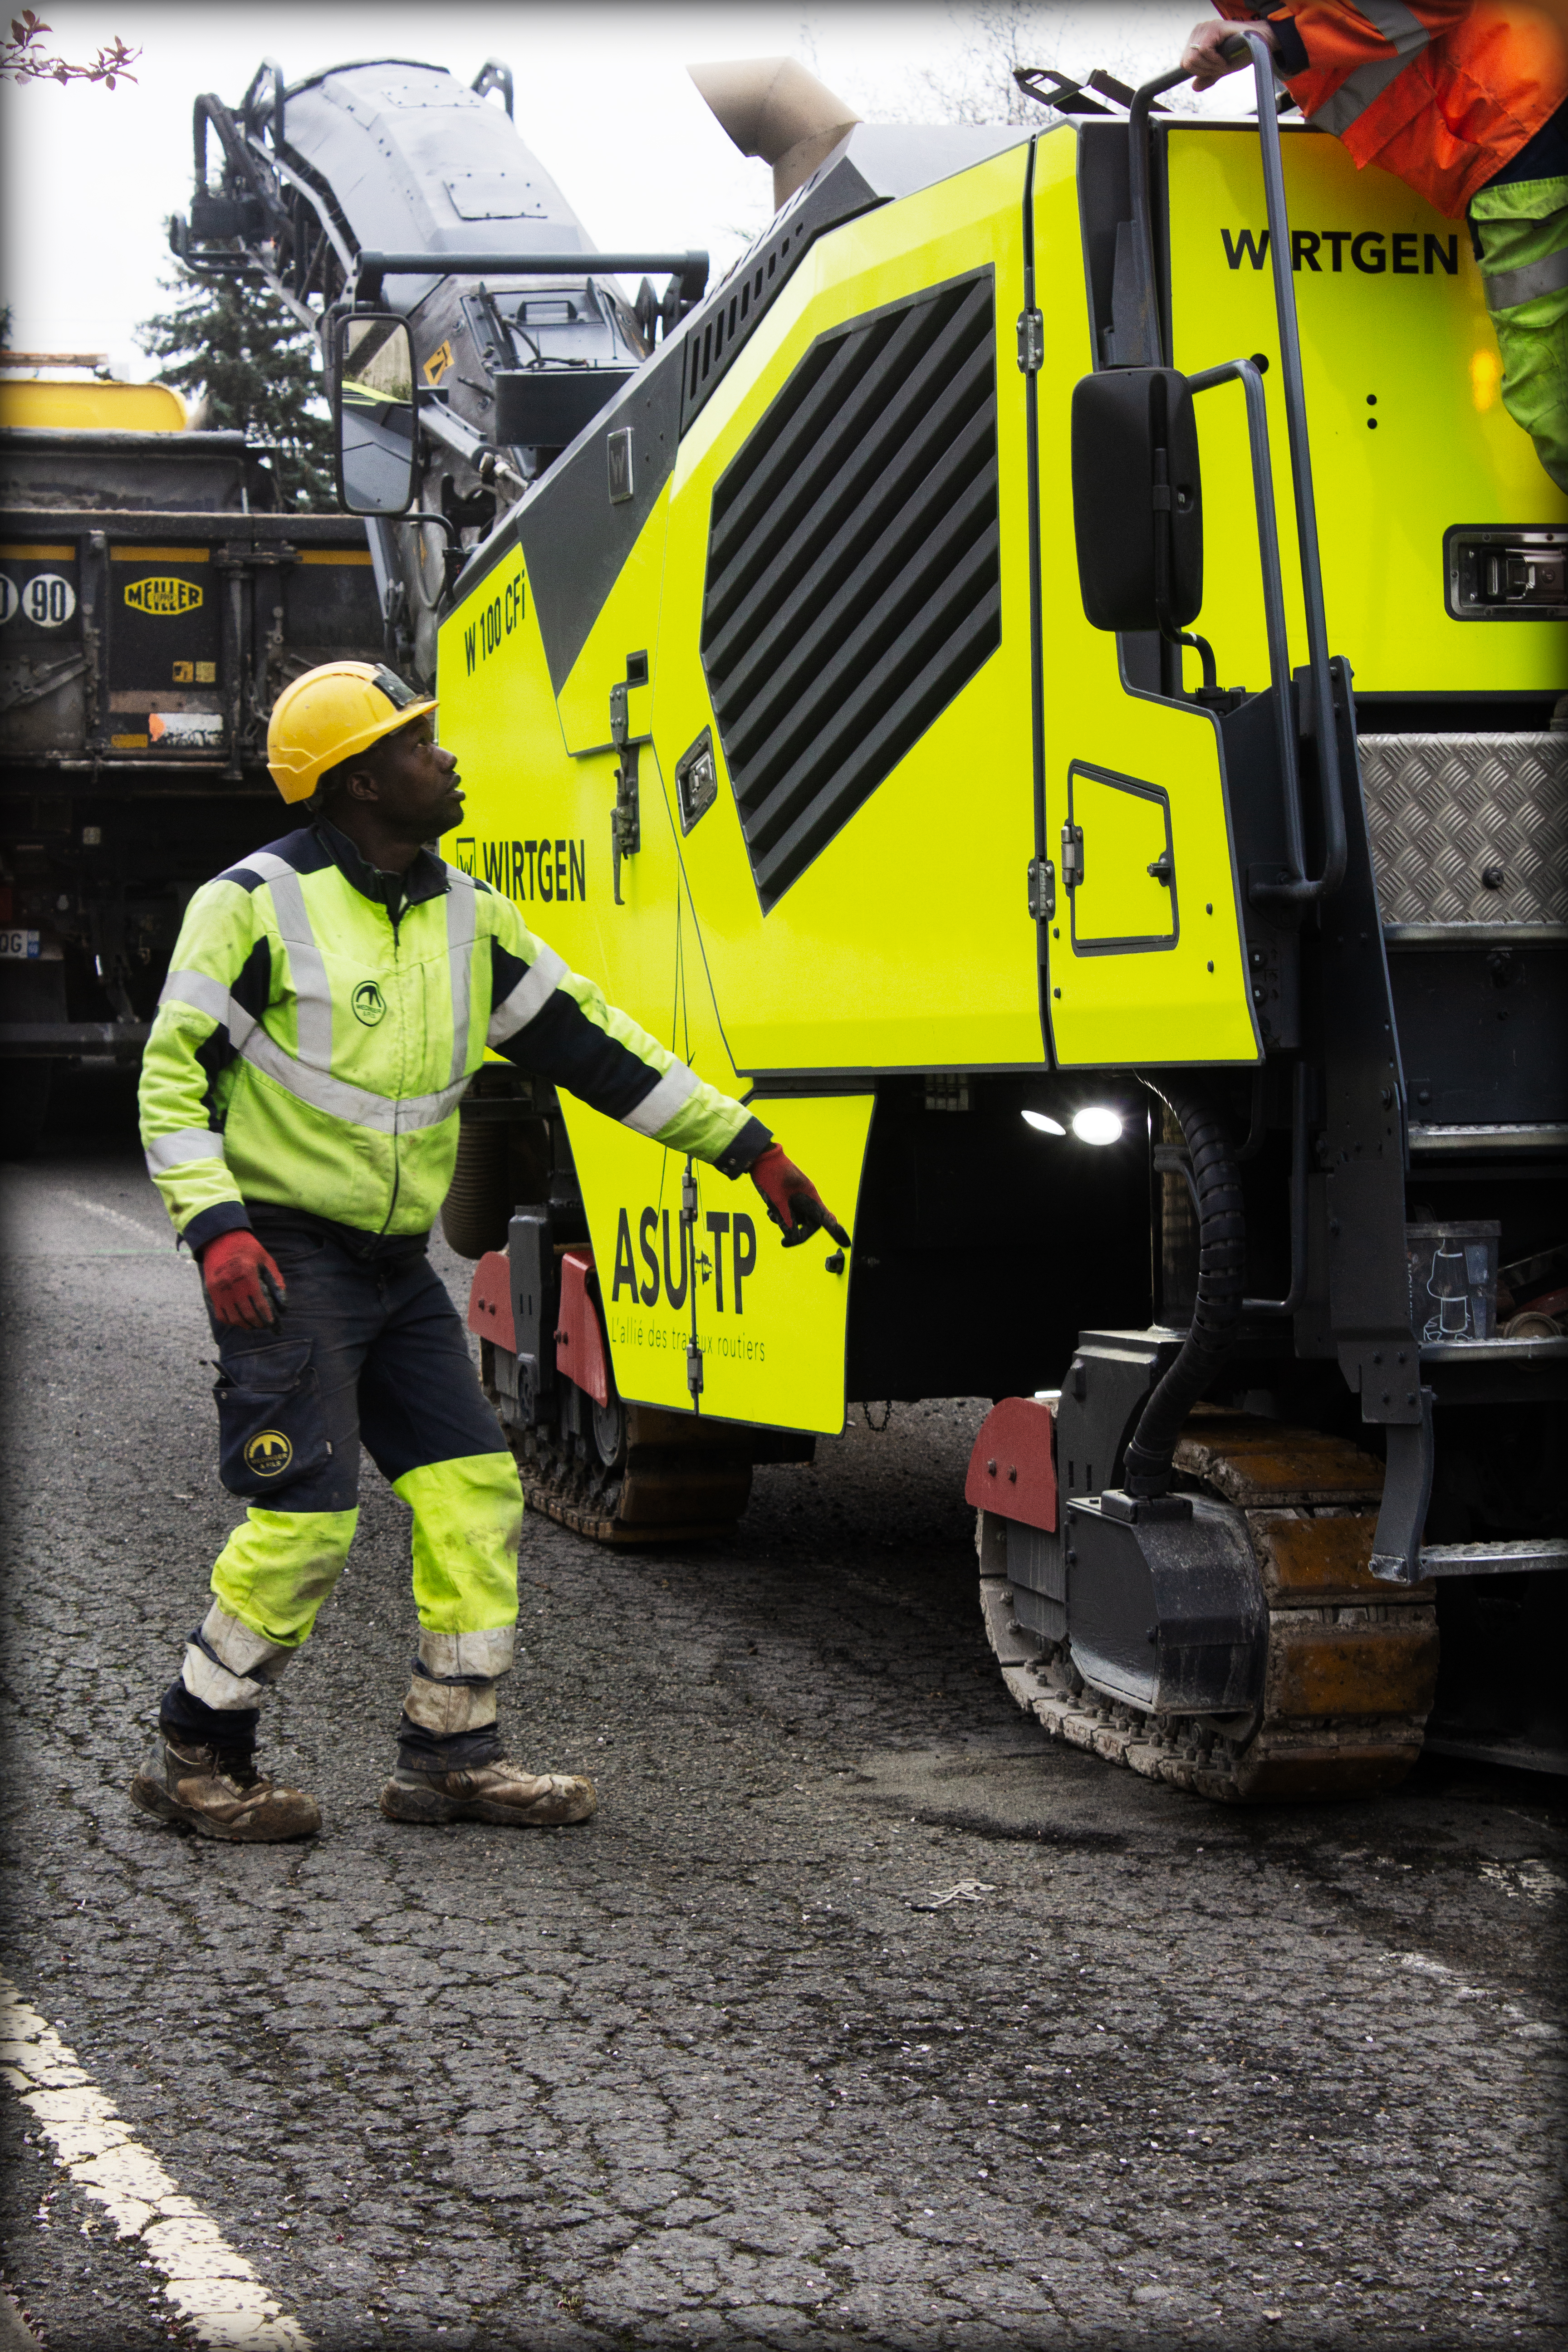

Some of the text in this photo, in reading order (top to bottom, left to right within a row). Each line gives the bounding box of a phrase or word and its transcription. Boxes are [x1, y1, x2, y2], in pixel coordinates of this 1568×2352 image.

[1220, 228, 1458, 274] WRTGEN
[32, 580, 66, 622] 90
[128, 581, 199, 611] MEILLER
[465, 569, 525, 677] W 100 CFi
[483, 839, 585, 902] WIRTGEN
[612, 1317, 764, 1362] L'allié des traaux routiers
